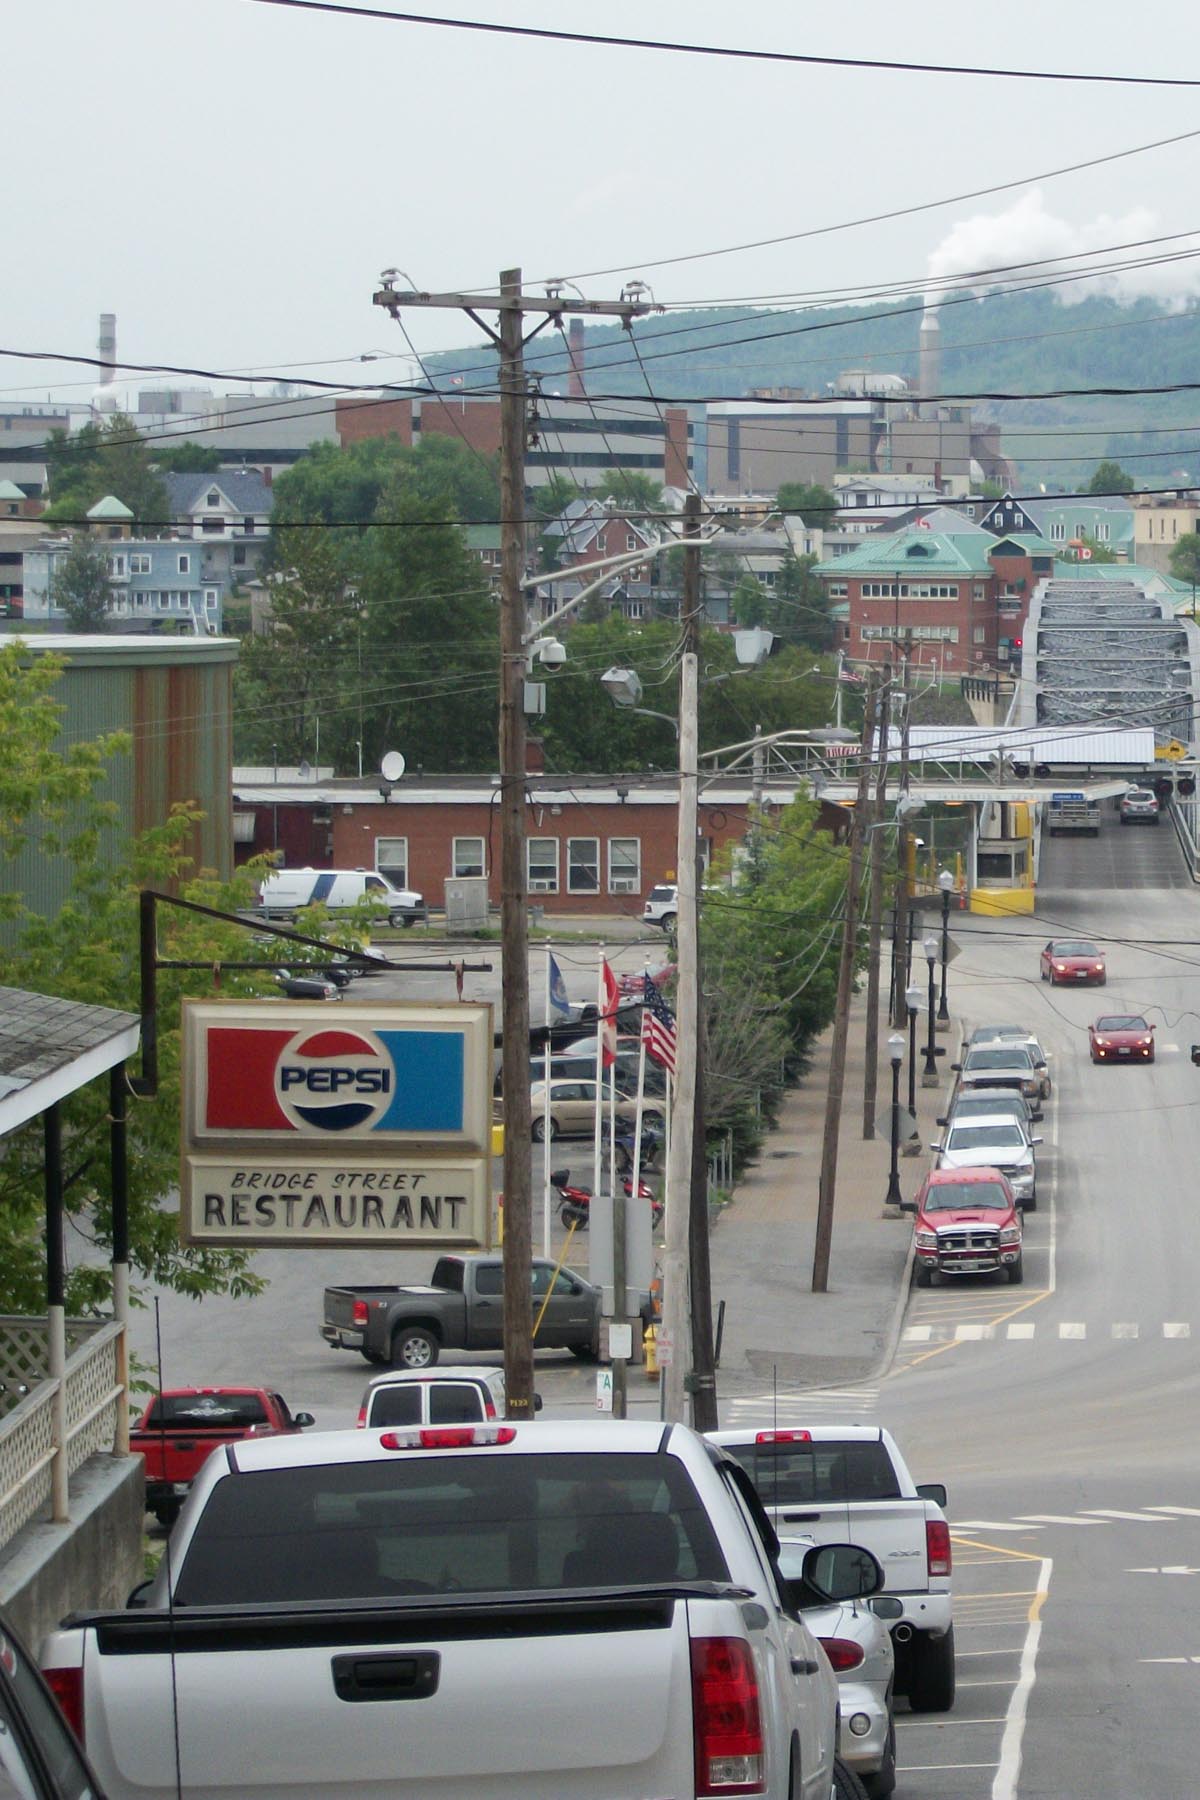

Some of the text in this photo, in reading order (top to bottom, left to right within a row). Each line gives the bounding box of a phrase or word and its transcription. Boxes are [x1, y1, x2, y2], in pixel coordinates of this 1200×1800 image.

[281, 1066, 390, 1093] PEPSI
[230, 1172, 427, 1190] BRIDGE STREET
[203, 1193, 467, 1229] RESTAURANT
